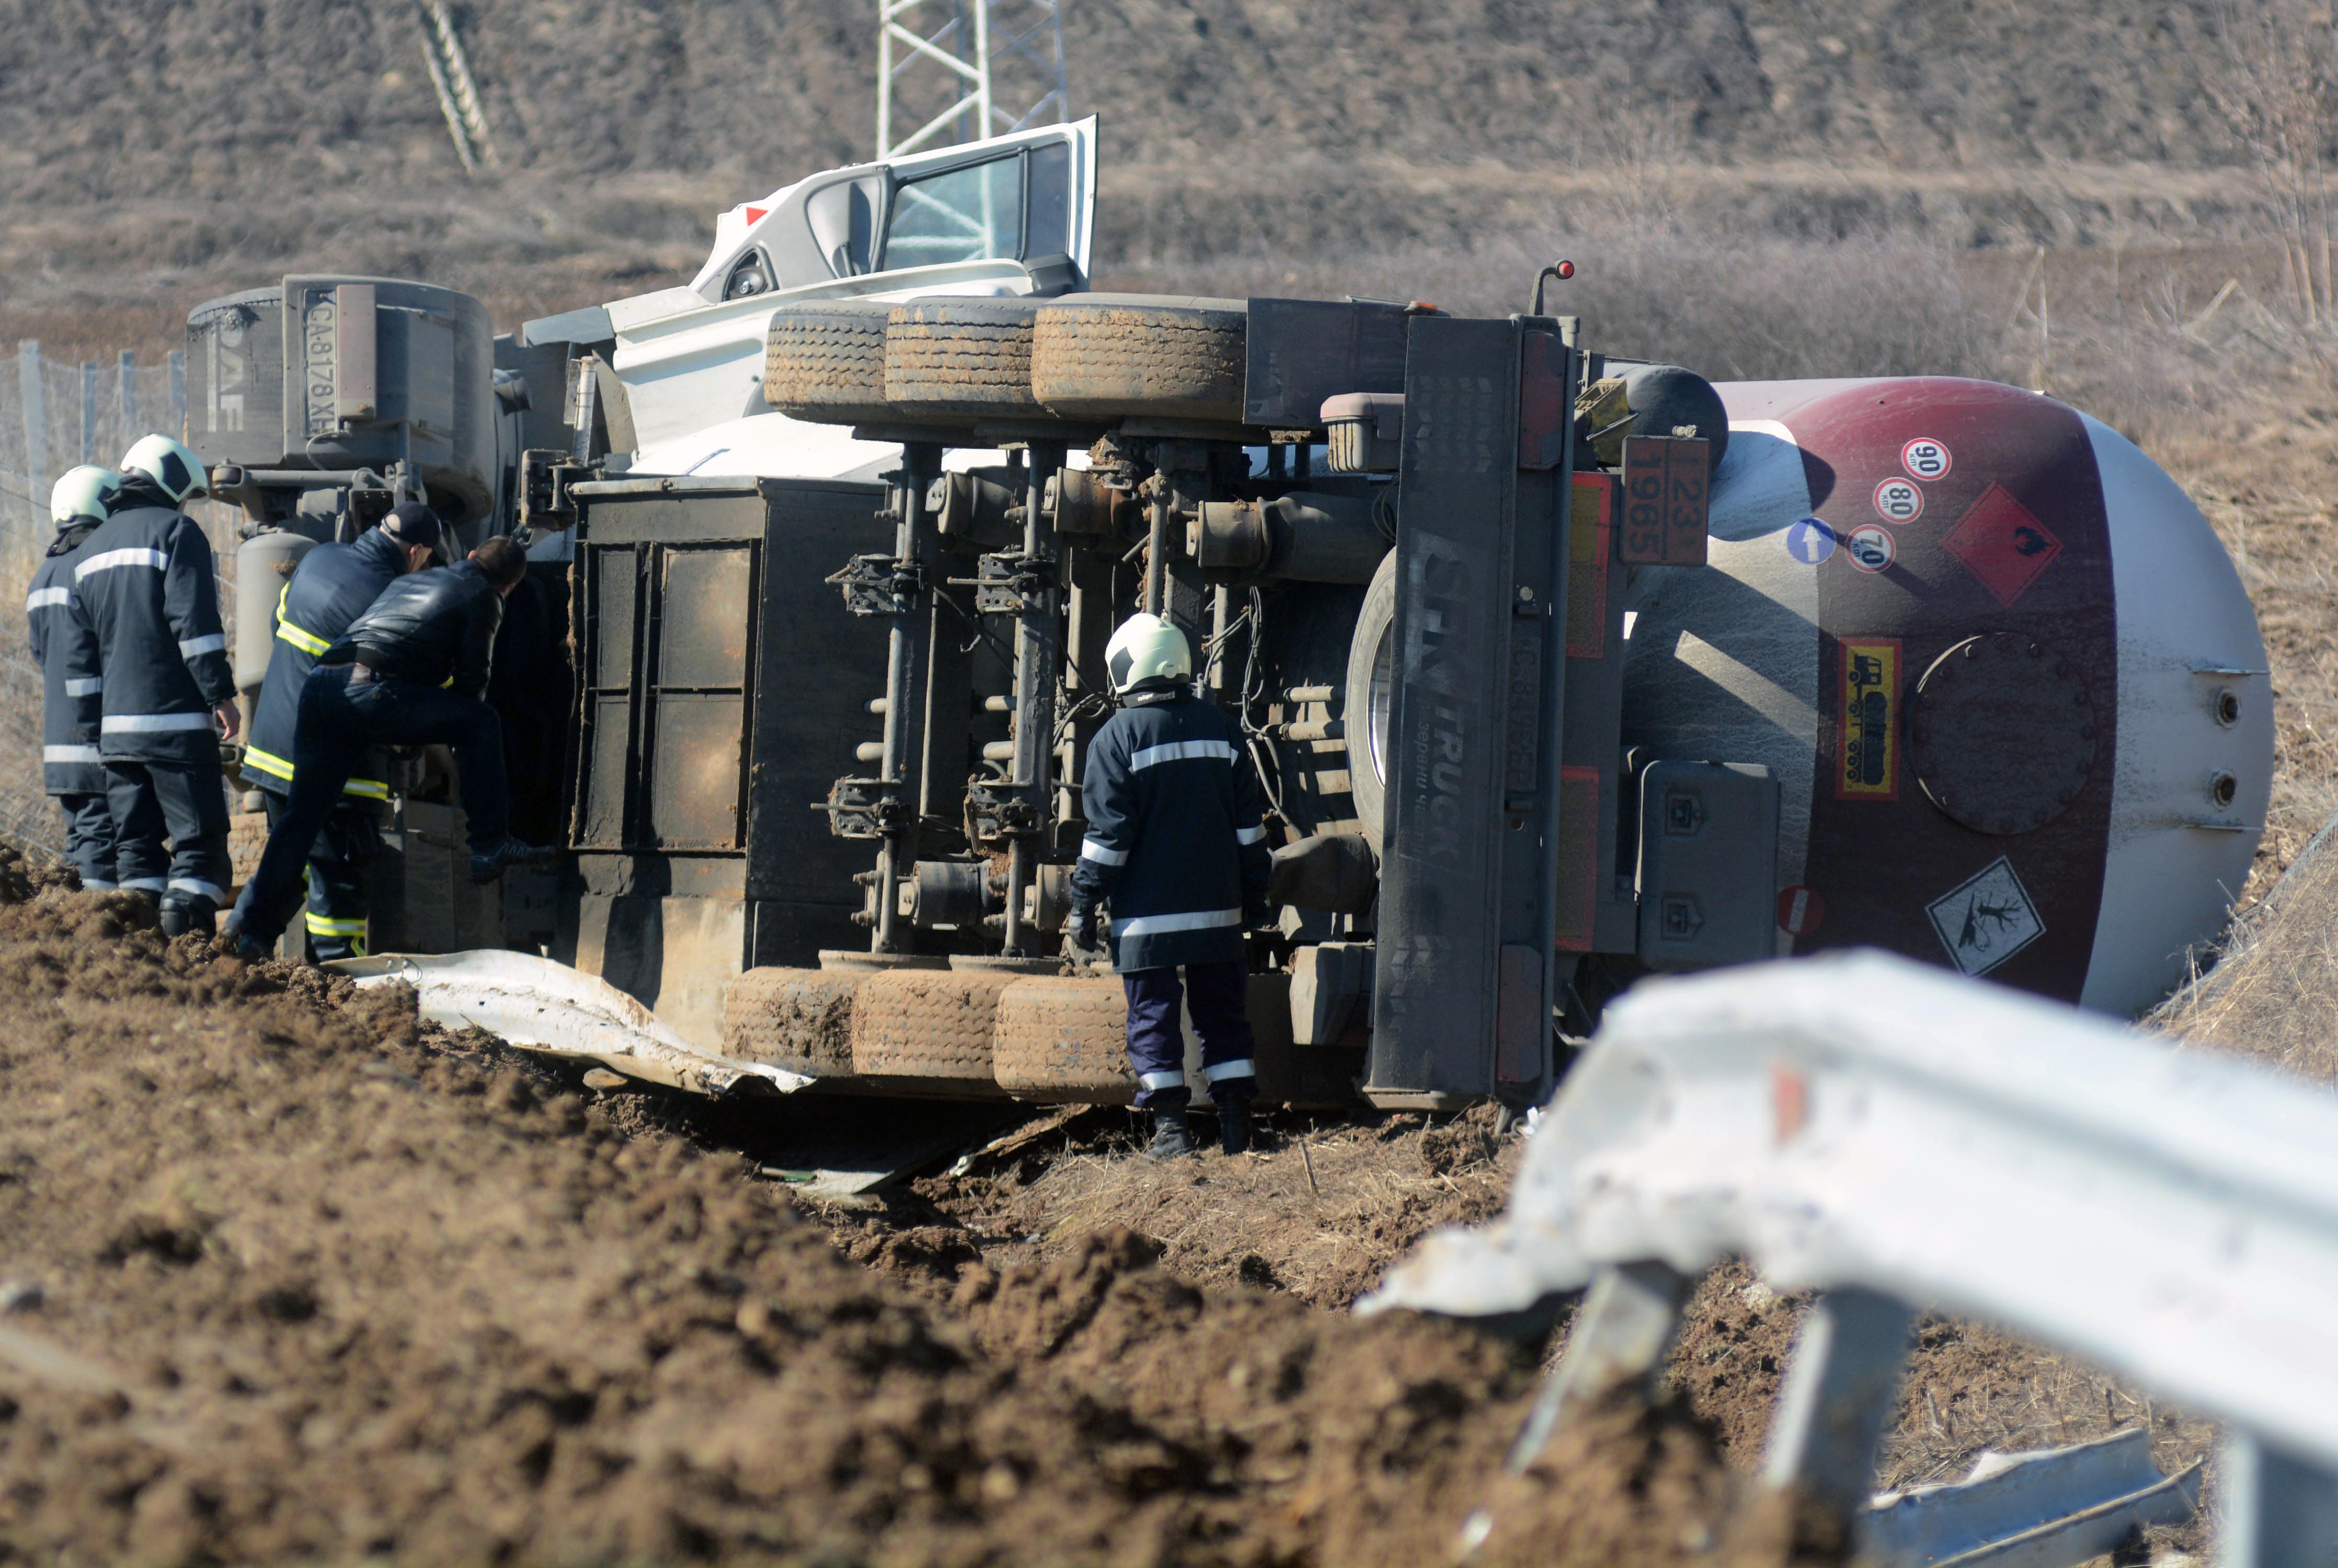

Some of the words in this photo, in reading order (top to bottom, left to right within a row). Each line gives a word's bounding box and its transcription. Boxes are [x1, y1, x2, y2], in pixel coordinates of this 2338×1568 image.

[309, 342, 334, 397] 8178
[1915, 446, 1941, 472] 90
[1629, 456, 1661, 554] 1965
[1889, 488, 1913, 515] 80
[1860, 534, 1885, 564] 70
[1428, 702, 1464, 861] TRUCK
